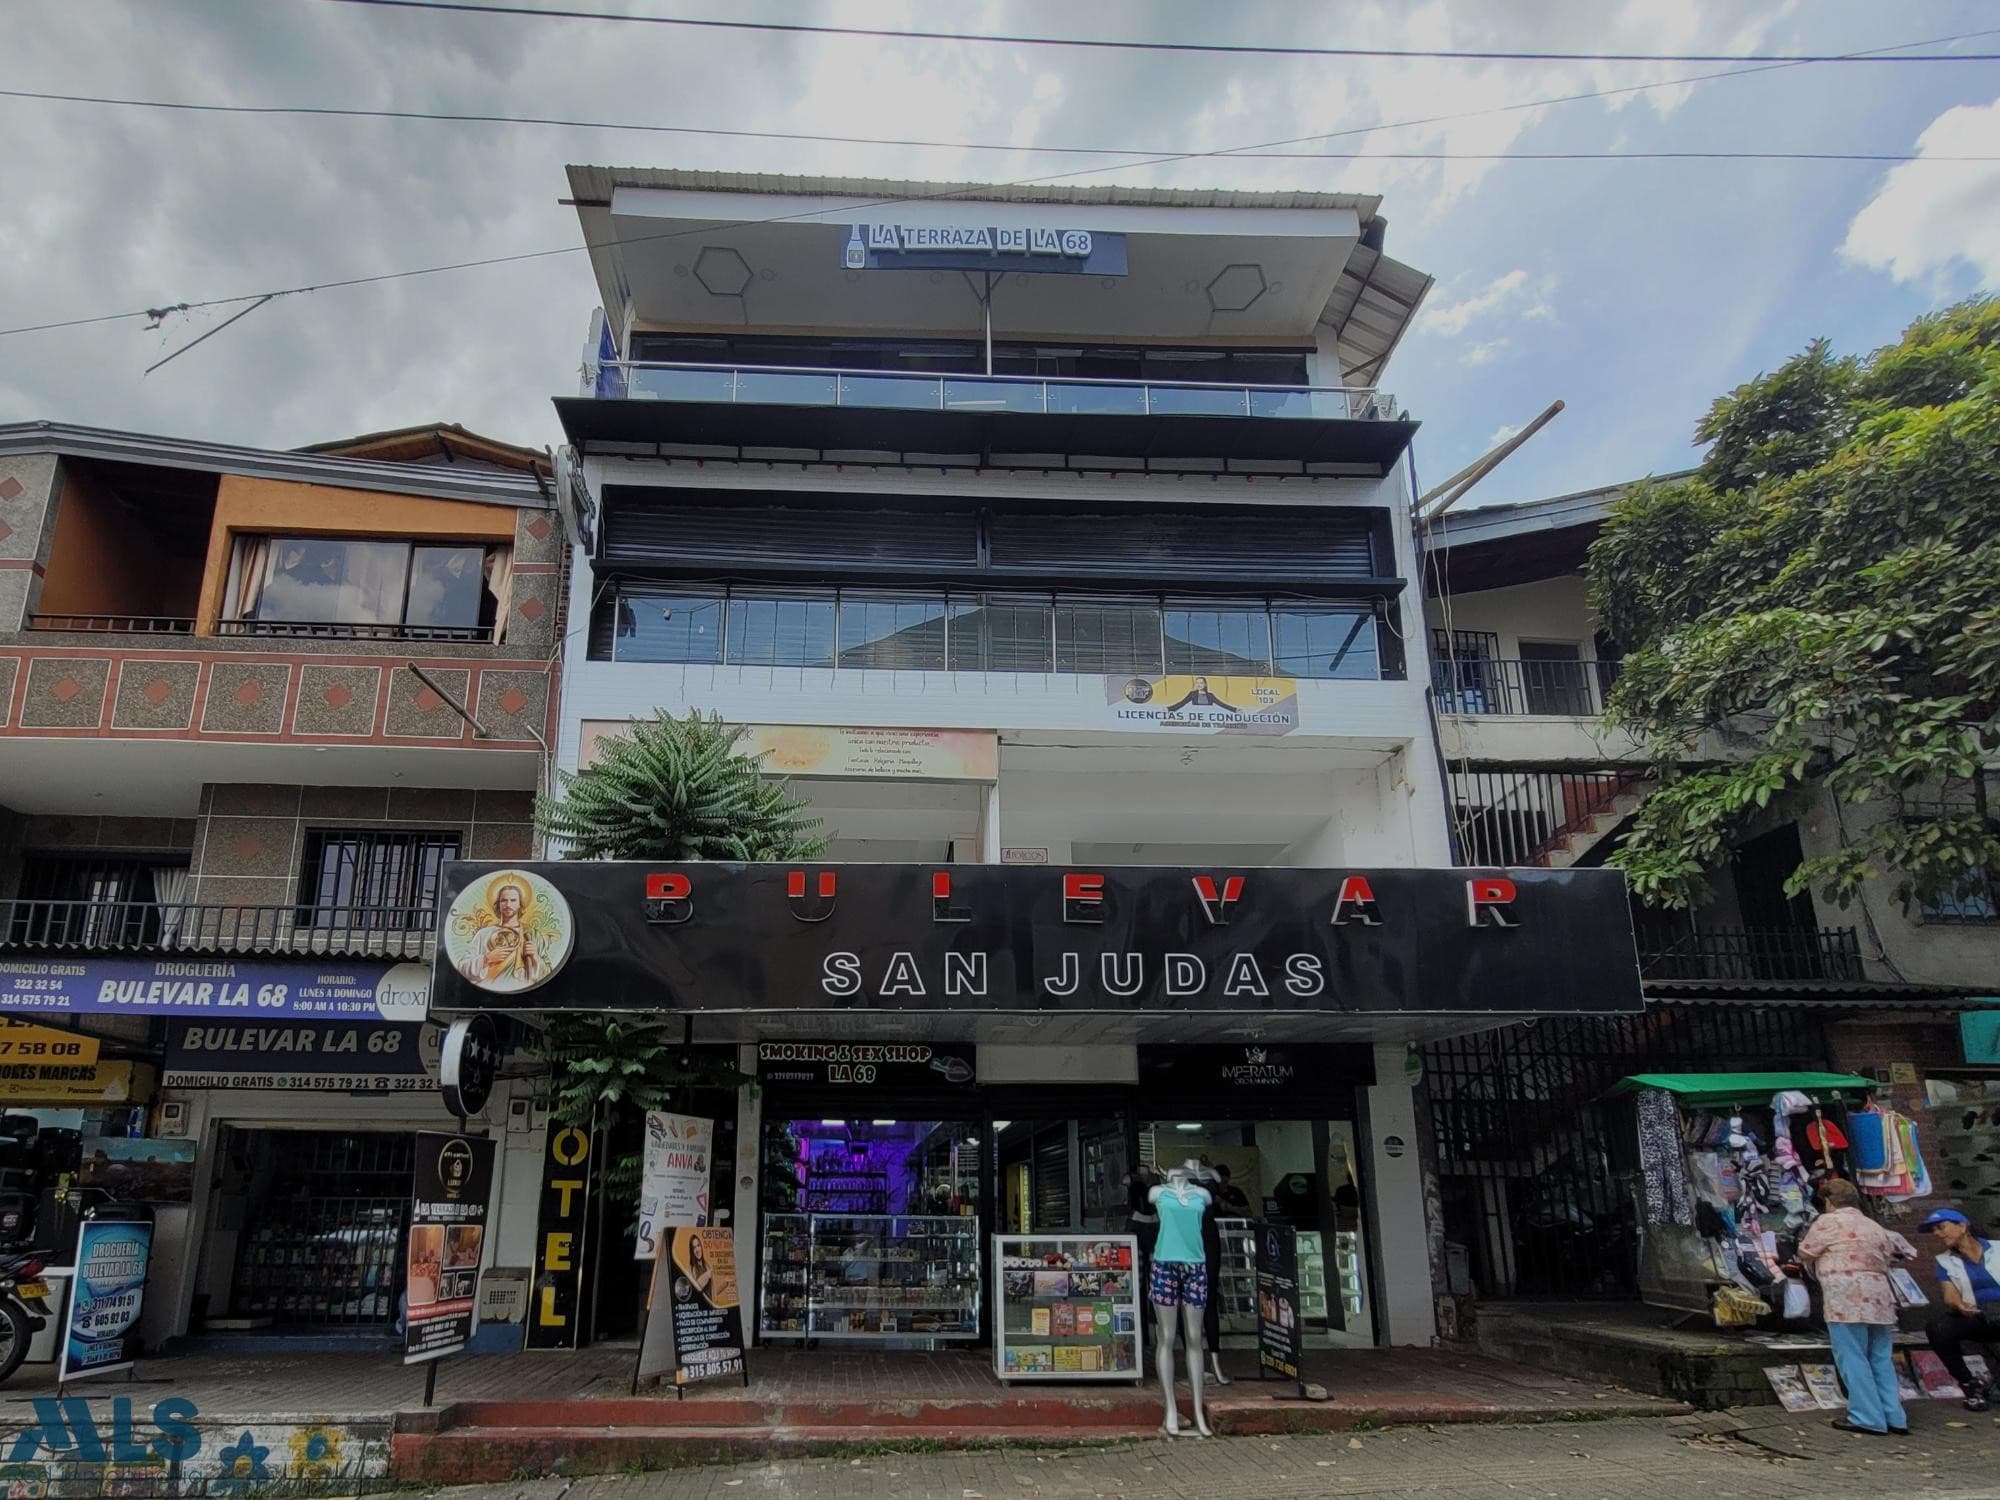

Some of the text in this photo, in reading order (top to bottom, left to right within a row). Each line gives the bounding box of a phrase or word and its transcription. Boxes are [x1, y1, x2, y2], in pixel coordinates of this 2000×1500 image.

[872, 227, 1090, 250] LA TERRAZA DE LA 68
[1250, 688, 1280, 696] LOCAL
[1259, 696, 1274, 704] 103
[1117, 710, 1290, 724] LICENCIAS DE CONDUCCIÓN
[646, 871, 1521, 928] BULEVAR
[50, 964, 87, 976] GRATIS
[154, 961, 236, 978] DROGUERÍA
[821, 951, 1325, 996] SAN JUDAS
[14, 979, 63, 991] 322 32 54
[317, 974, 357, 985] HORARIO:
[1, 993, 71, 1007] 314 575 79 21
[97, 979, 288, 1007] BULEVAR LA 68
[299, 987, 373, 999] LUNES A DOMINGO
[292, 1001, 376, 1012] 8:00 AM A 10:30 PM
[182, 1026, 314, 1052] BULEVAR
[321, 1029, 358, 1053] LA
[366, 1030, 402, 1053] 68
[18, 1042, 47, 1055] 58
[51, 1042, 81, 1056] 08
[760, 1043, 932, 1062] SMOKING & SEX SHOP
[39, 1065, 97, 1081] MARCAS
[828, 1065, 852, 1083] LA
[853, 1065, 876, 1083] 68
[1221, 1065, 1294, 1078] IMPERATUM
[167, 1074, 229, 1088] DOMICILIO
[232, 1075, 274, 1088] GRATIS
[289, 1076, 311, 1088] 314
[314, 1077, 336, 1088] 575
[338, 1077, 353, 1088] 79
[355, 1077, 370, 1089] 21
[394, 1078, 416, 1089] 322
[418, 1078, 433, 1089] 32
[667, 1152, 694, 1170] ANVA
[540, 1094, 589, 1327] OTEL
[92, 1239, 140, 1258] DROGUERÍA
[82, 1261, 143, 1279] BULEVAR LA 68
[92, 1297, 104, 1311] 311
[110, 1312, 120, 1324] 92
[120, 1311, 130, 1323] 03
[689, 1358, 743, 1378] 315 805 57 91
